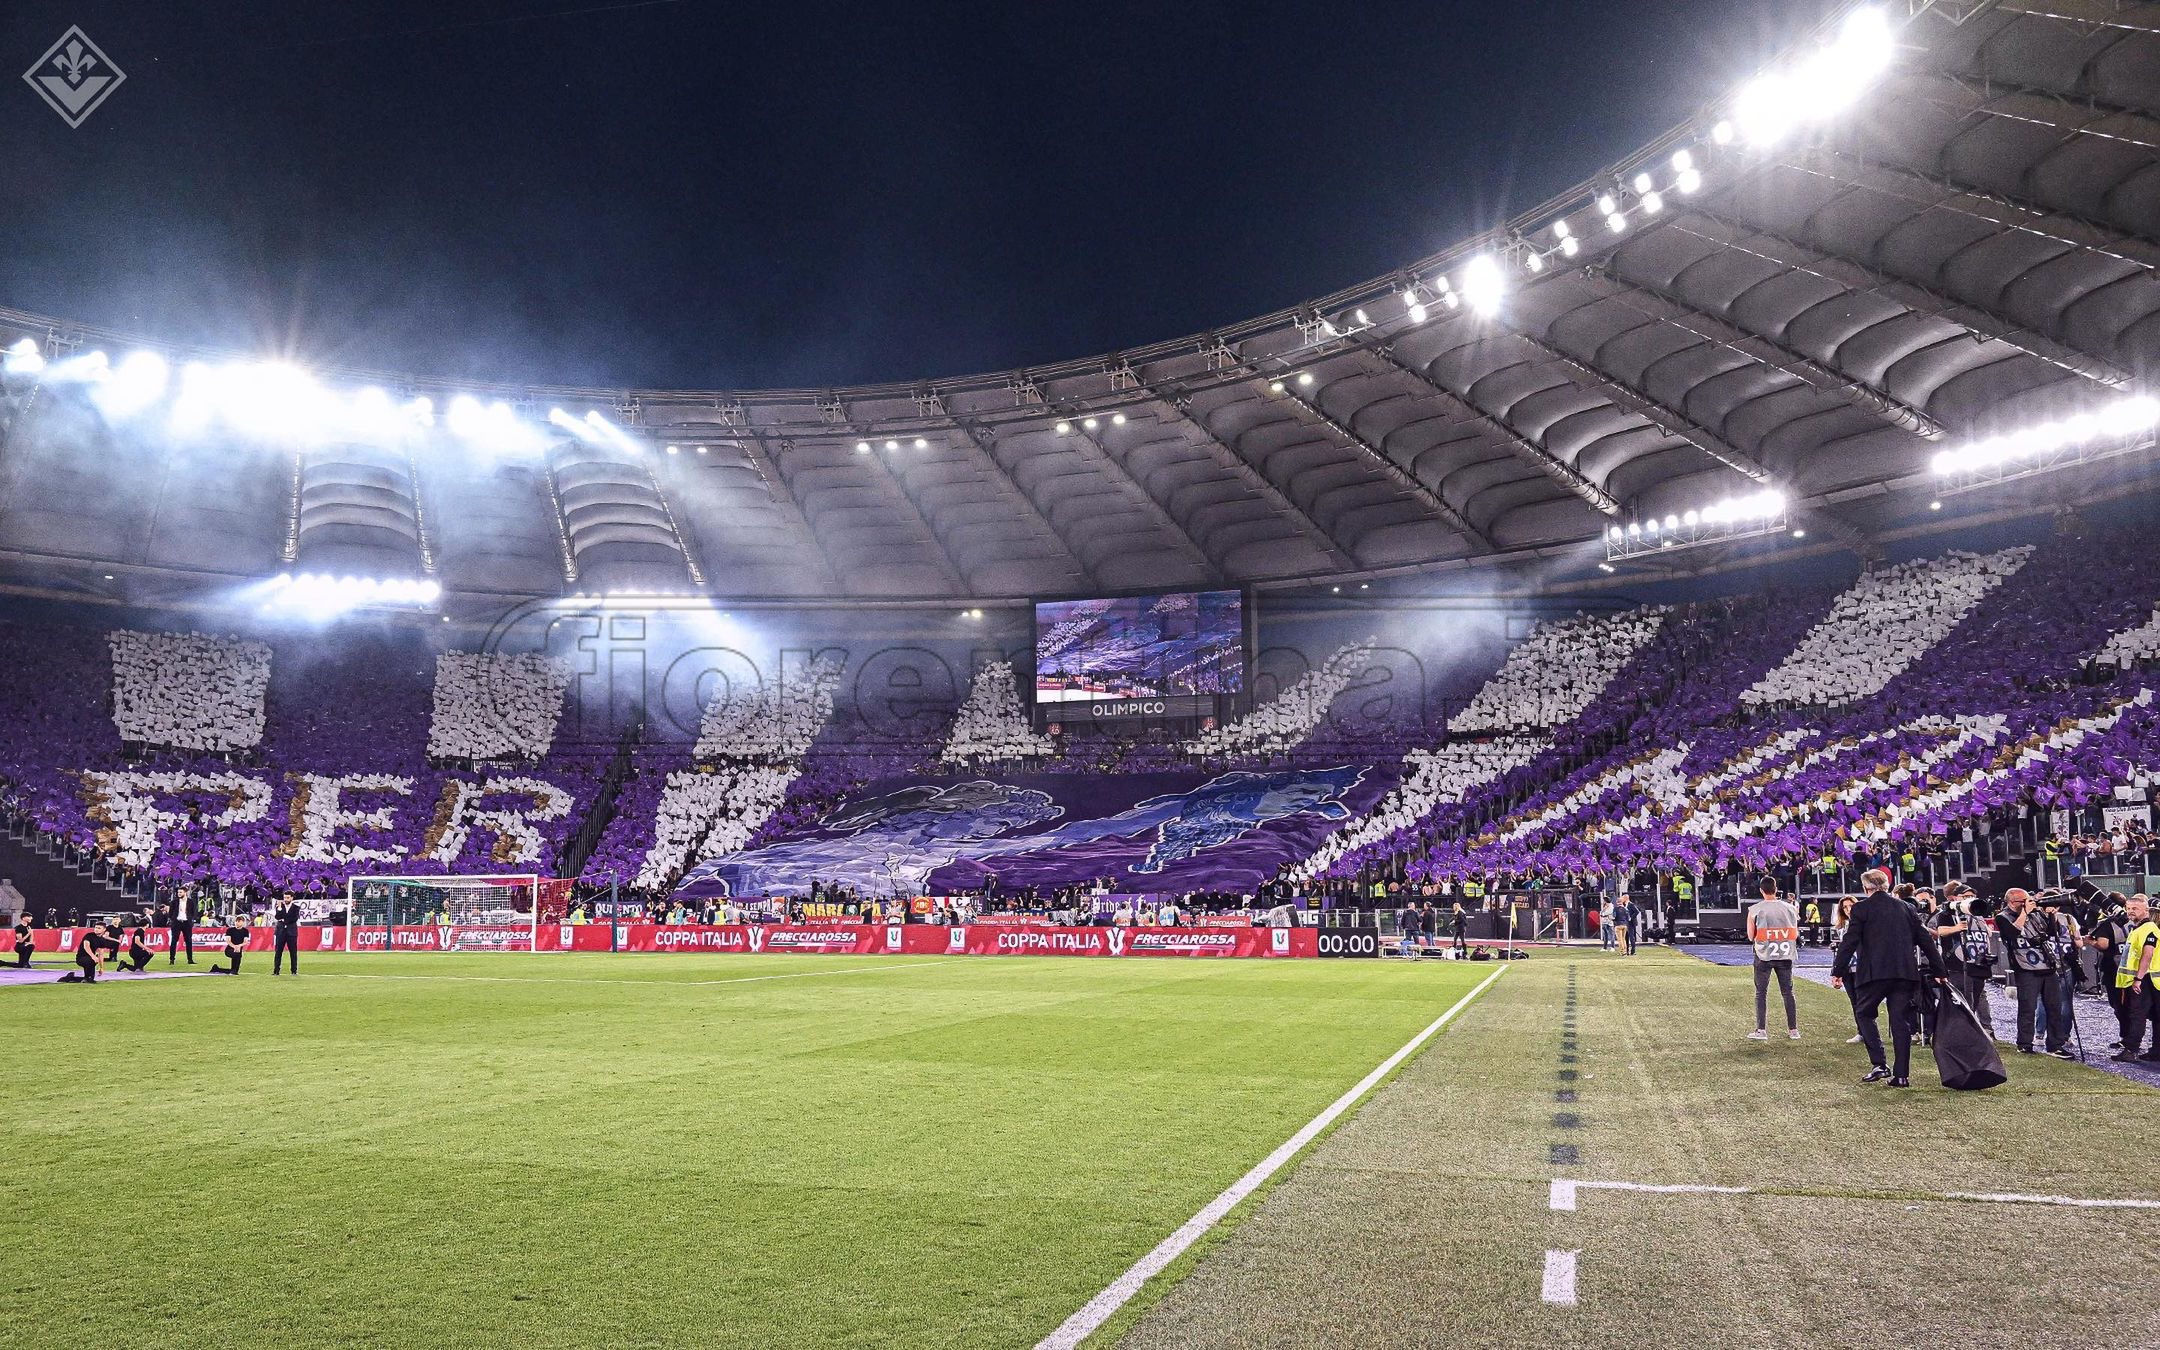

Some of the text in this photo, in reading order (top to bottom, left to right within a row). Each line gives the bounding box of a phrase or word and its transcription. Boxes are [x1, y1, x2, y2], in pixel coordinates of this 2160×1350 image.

[1092, 701, 1166, 717] OLIMPICO
[78, 766, 577, 870] PER
[397, 931, 435, 945] ITALIA
[655, 931, 743, 946] COPPA ITALIA
[769, 932, 857, 942] FRECCIAROSSA
[998, 933, 1101, 949] COPPA ITALIA
[1133, 934, 1236, 945] FRECCIAROSSA
[1766, 928, 1790, 940] FTV
[1318, 934, 1375, 953] 00:00
[1768, 942, 1791, 957] 29
